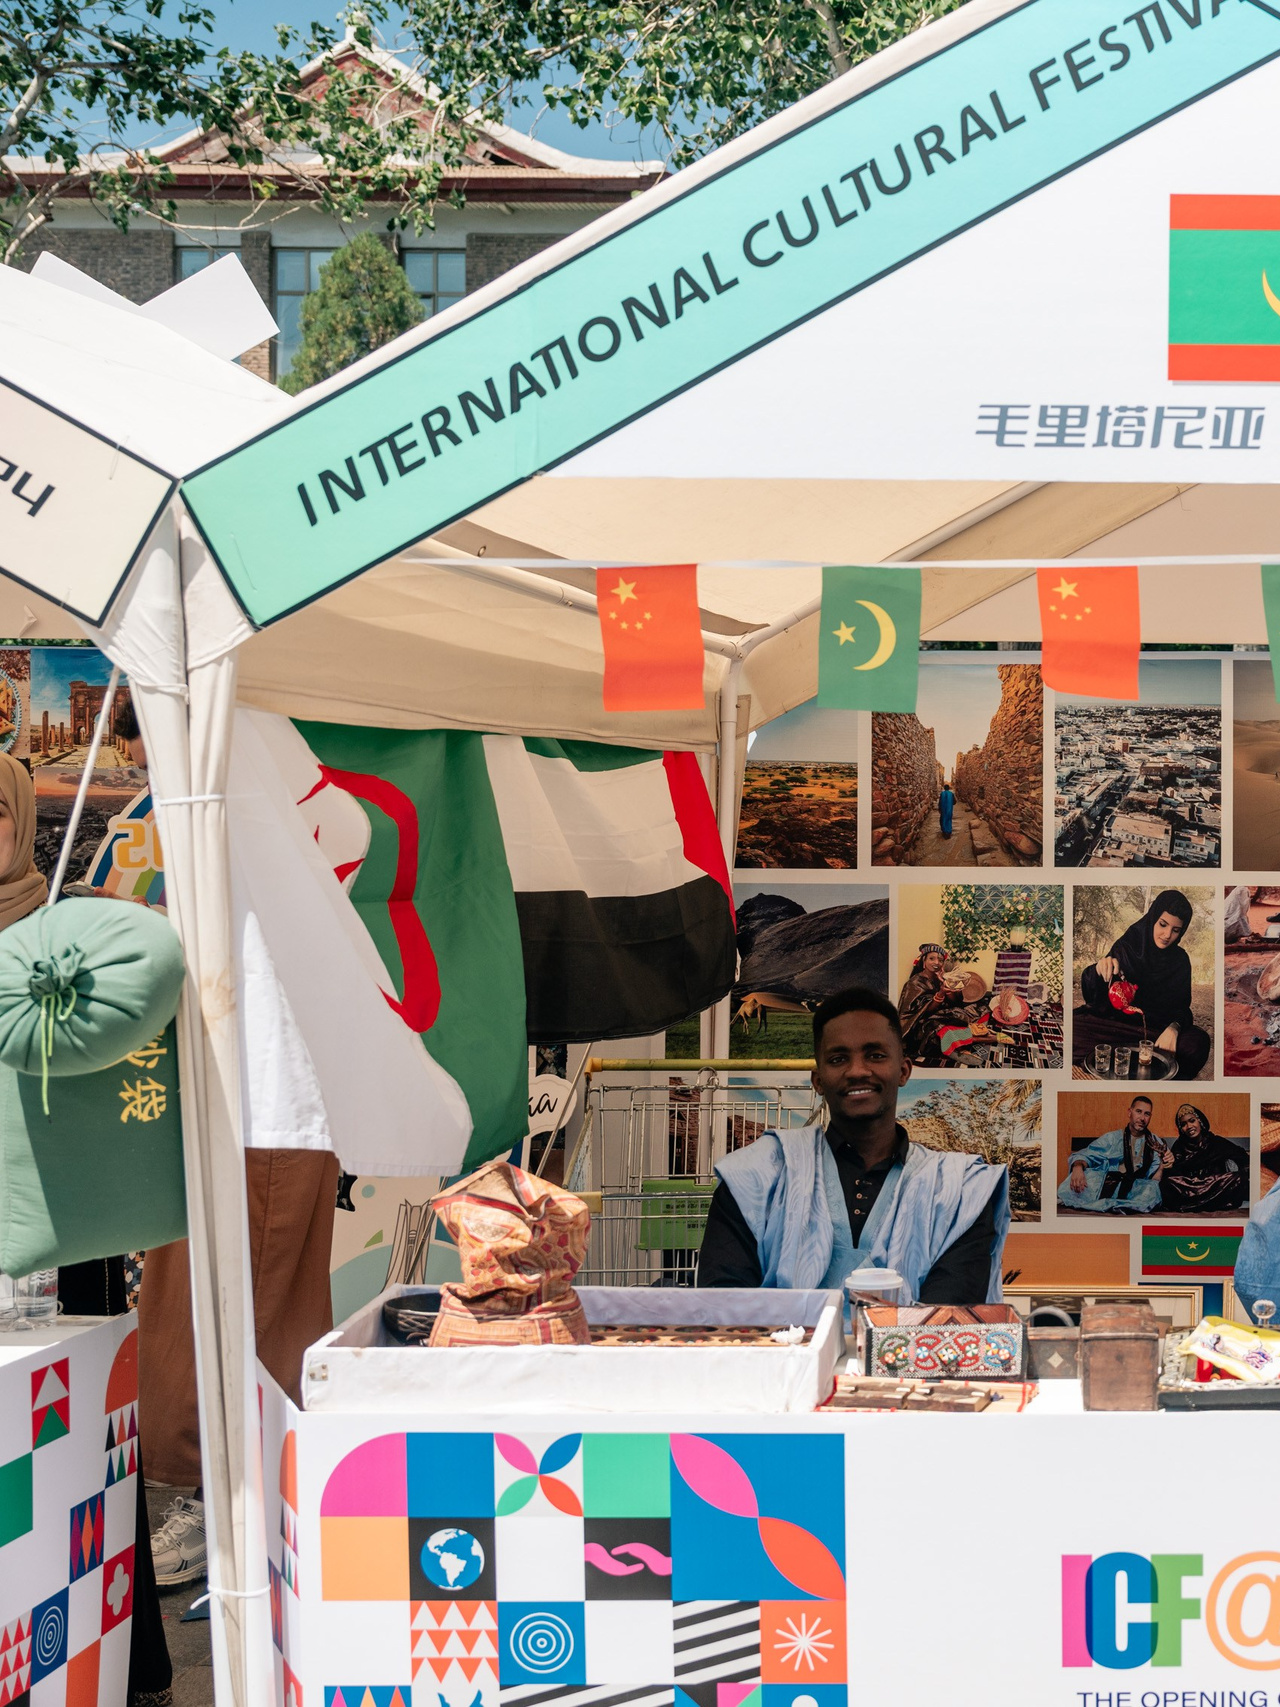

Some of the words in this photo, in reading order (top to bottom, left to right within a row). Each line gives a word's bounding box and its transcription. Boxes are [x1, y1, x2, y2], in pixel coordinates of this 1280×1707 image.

[297, 252, 739, 527] INTERNATIONAL
[742, 90, 1026, 268] CULTURAL
[975, 403, 1266, 450] 毛里塔尼亚
[1076, 1691, 1131, 1707] THE
[1140, 1689, 1268, 1707] OPENING
